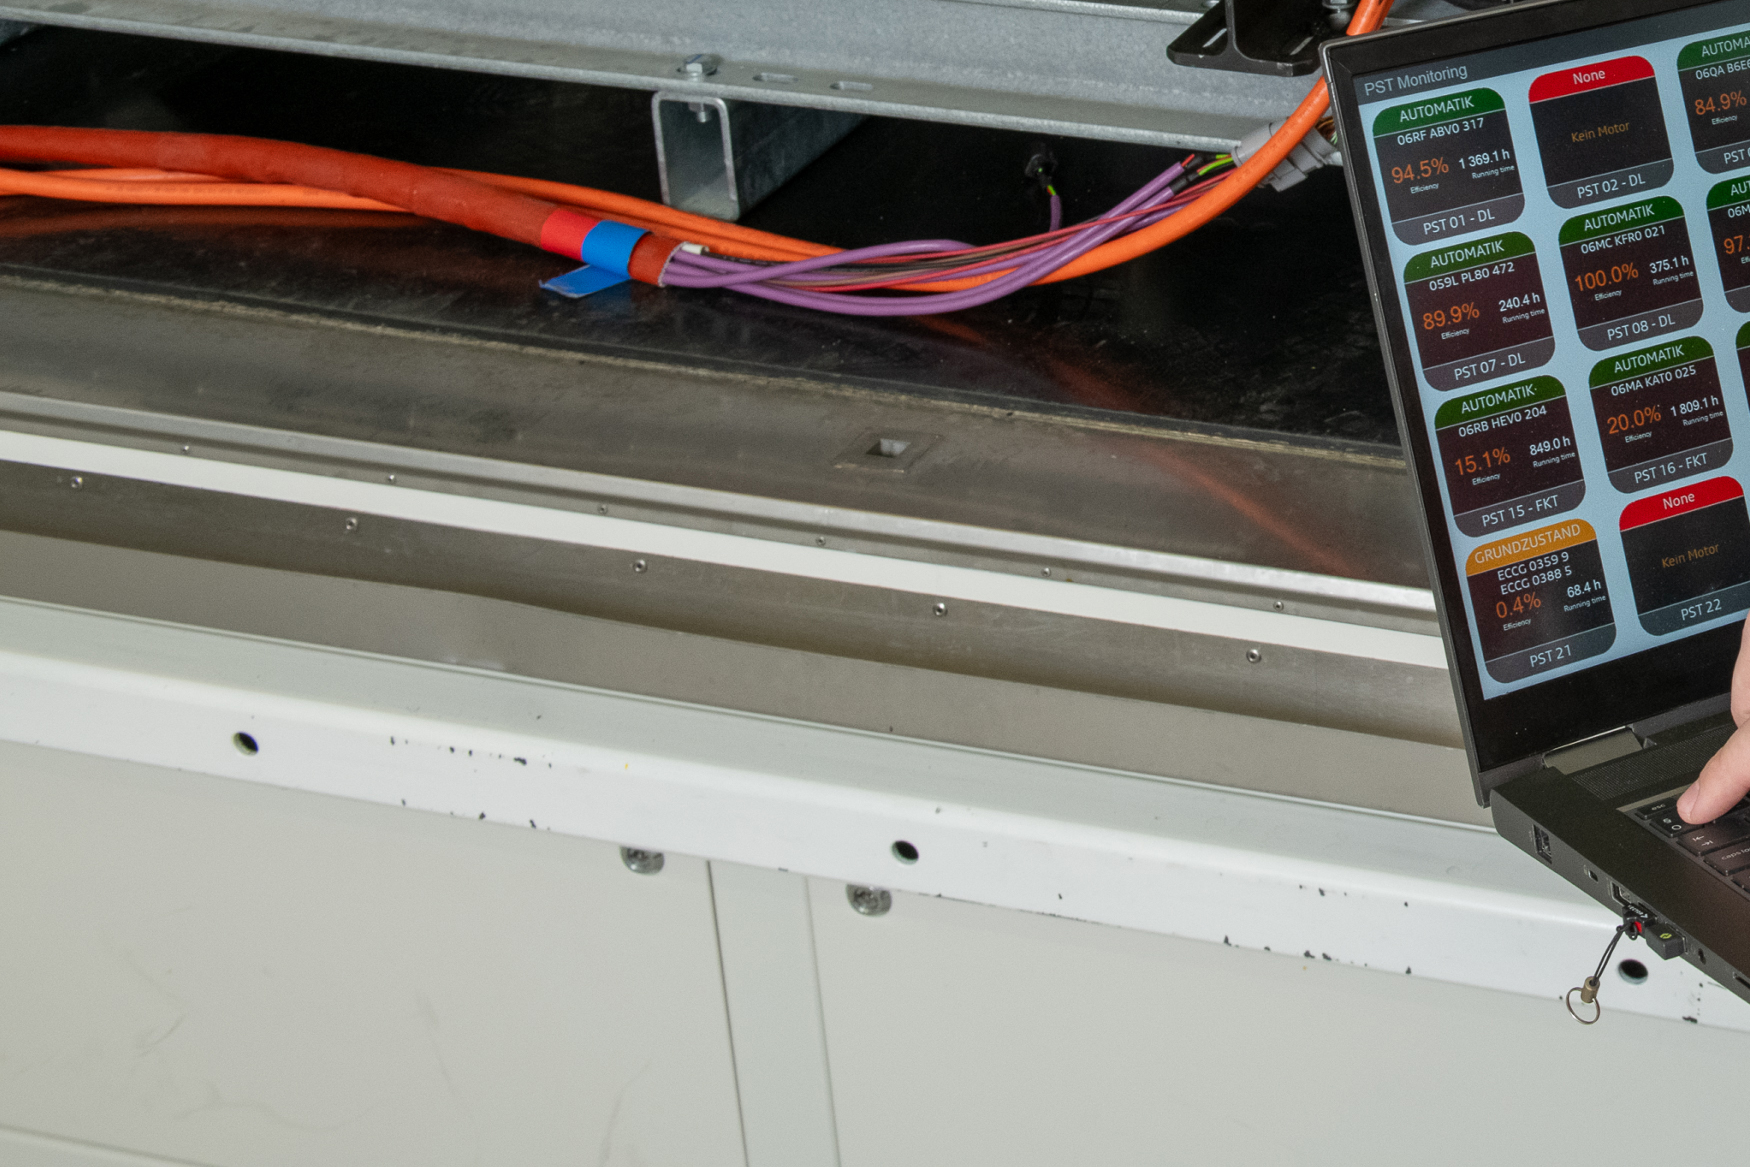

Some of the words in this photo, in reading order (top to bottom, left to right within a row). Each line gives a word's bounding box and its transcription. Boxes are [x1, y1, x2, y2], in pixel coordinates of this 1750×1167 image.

[1364, 78, 1394, 97] PST
[1397, 65, 1468, 90] Monitoring
[1572, 70, 1605, 84] None
[1399, 95, 1474, 122] AUTOMATIK
[1694, 90, 1747, 115] 84.9%
[1571, 130, 1596, 142] Kein
[1597, 122, 1629, 137] Motor
[1711, 115, 1738, 125] Efficiency
[1391, 157, 1449, 184] 94.5%
[1471, 168, 1499, 179] Running
[1499, 165, 1515, 173] time
[1409, 183, 1439, 194] Efficiency
[1576, 182, 1599, 199] PST
[1601, 178, 1619, 193] 02
[1628, 173, 1645, 187] DL
[1584, 203, 1655, 231] AUTOMATIK
[1430, 239, 1504, 268] AUTOMATIK
[1649, 256, 1678, 274] 375.1
[1680, 255, 1689, 266] h
[1574, 262, 1638, 291] 100.0%
[1498, 294, 1530, 312] 240.4
[1531, 292, 1540, 303] h
[1422, 302, 1480, 330] 89.9%
[1502, 312, 1530, 323] Running
[1529, 308, 1545, 317] time
[1440, 328, 1469, 340] Efficiency
[1614, 344, 1684, 373] AUTOMATIK
[1461, 383, 1535, 414] AUTOMATIK
[1606, 406, 1661, 434] 20.0%
[1529, 437, 1561, 456] 849.0
[1562, 435, 1571, 447] h
[1455, 447, 1510, 475] 15.1%
[1532, 456, 1560, 467] Running
[1560, 451, 1575, 460] time
[1634, 466, 1656, 484] PST
[1659, 461, 1676, 476] 16
[1685, 452, 1707, 469] FKT
[1471, 473, 1500, 486] Efficiency
[1662, 492, 1695, 510] None
[1474, 523, 1580, 563] GRUNDZUSTAND
[1661, 554, 1686, 568] Kein
[1687, 544, 1719, 561] Motor
[1495, 591, 1541, 618] 0.4%
[1680, 603, 1703, 621] PST
[1705, 598, 1722, 613] 22
[1529, 649, 1552, 667] PST
[1555, 644, 1571, 660] 21
[1721, 848, 1740, 861] caps
